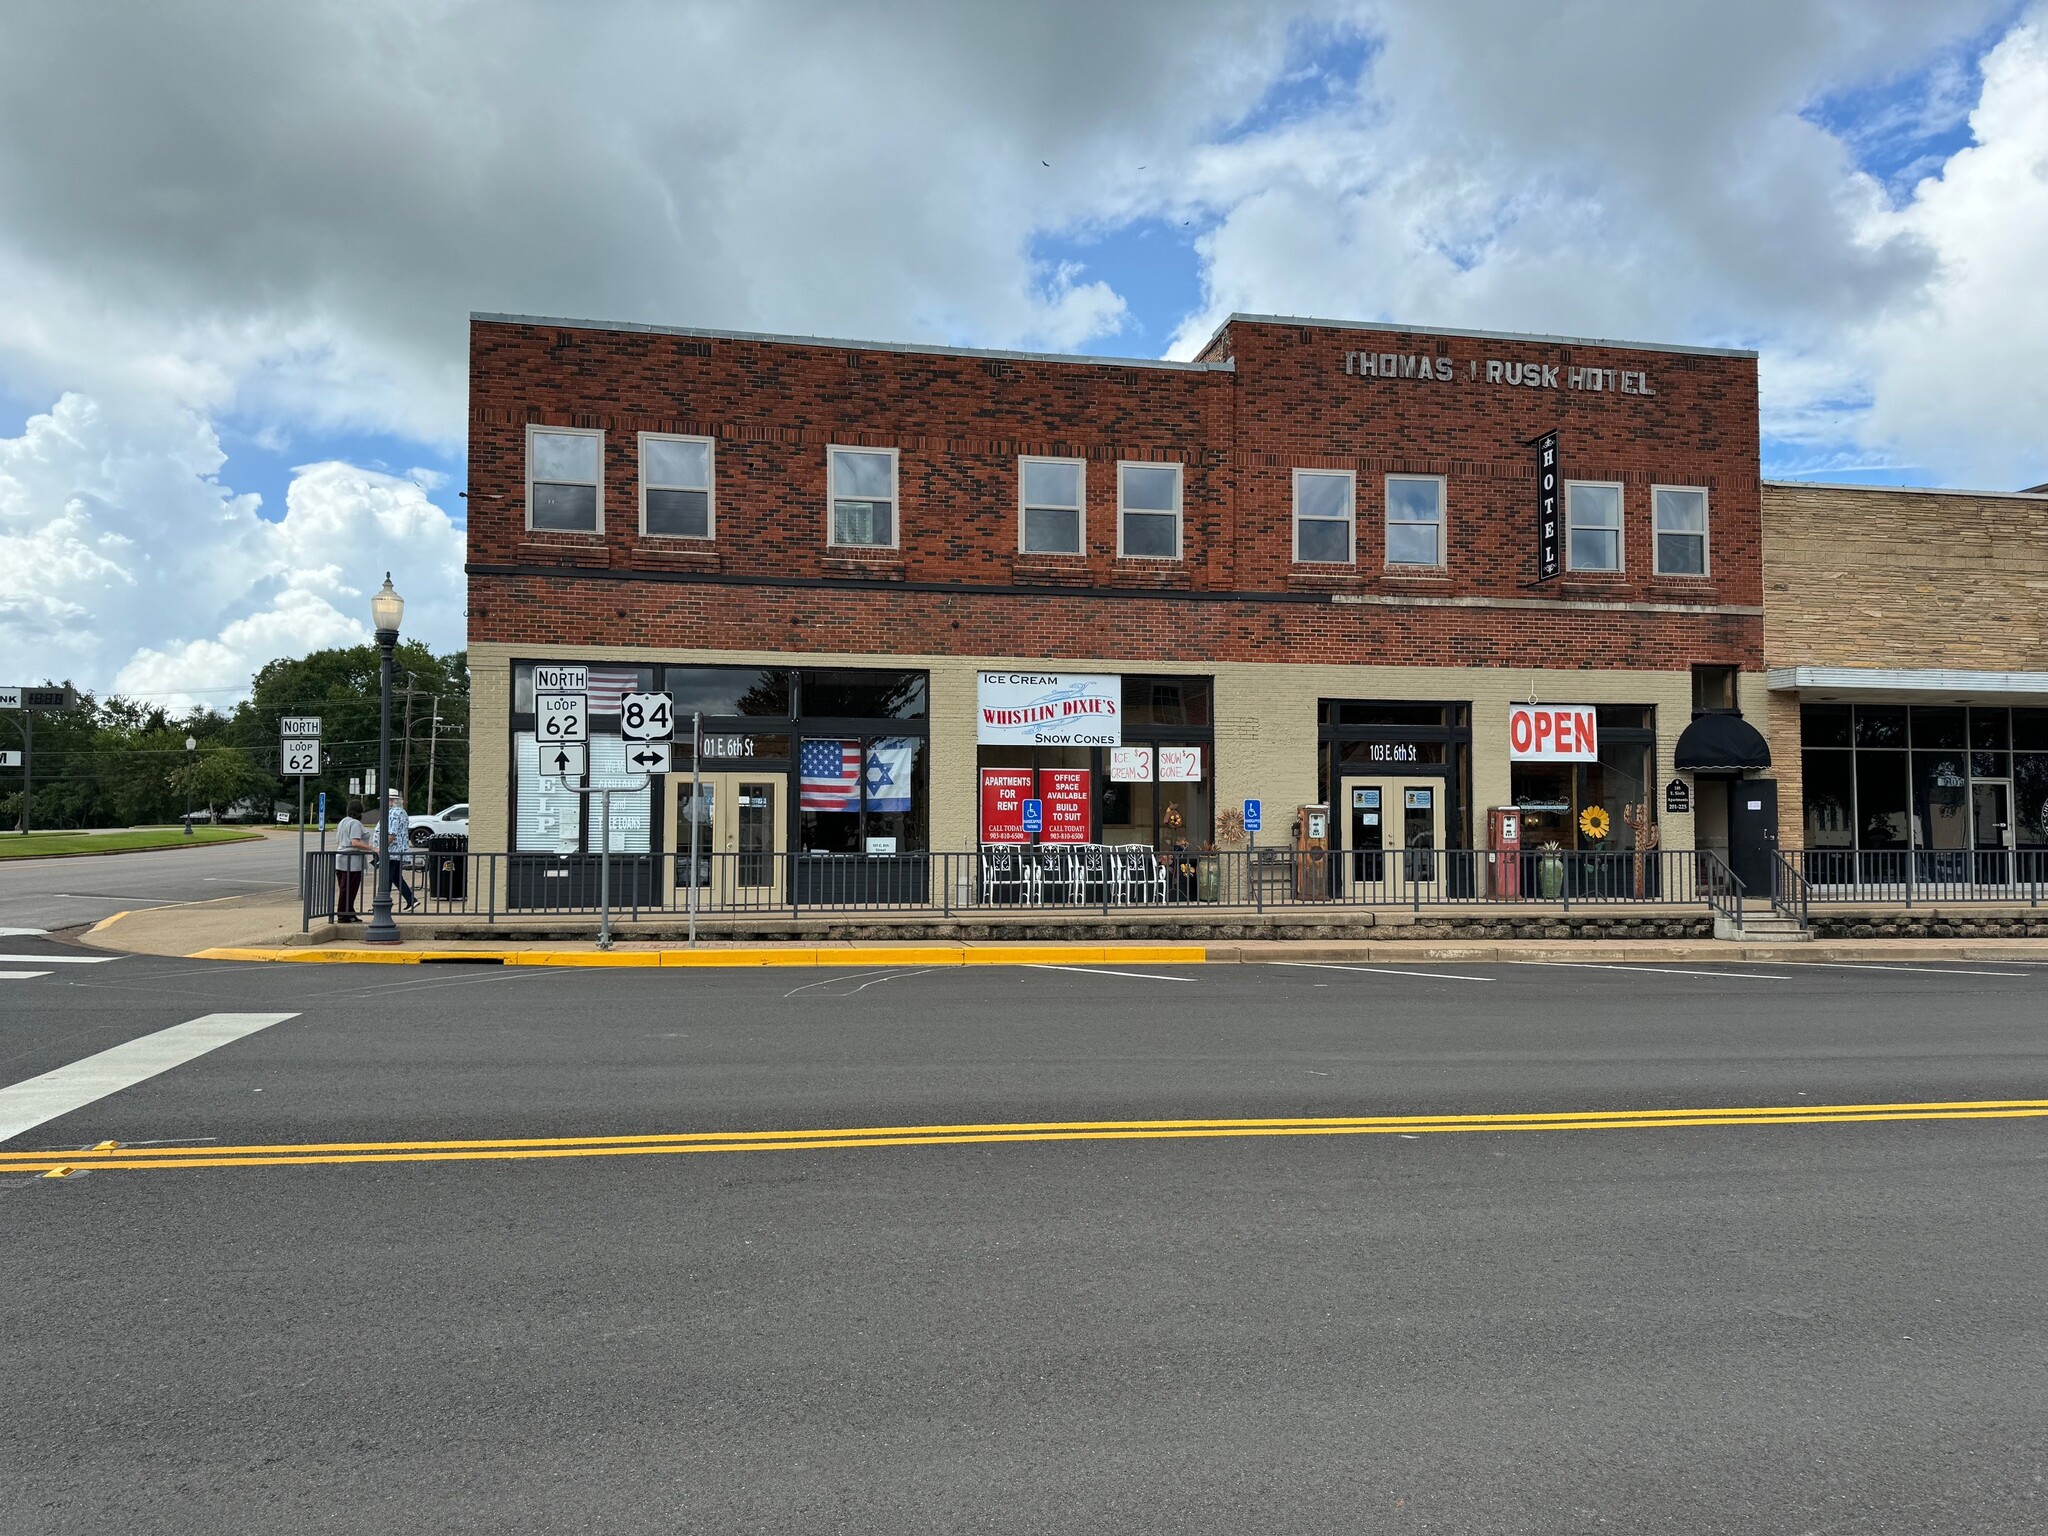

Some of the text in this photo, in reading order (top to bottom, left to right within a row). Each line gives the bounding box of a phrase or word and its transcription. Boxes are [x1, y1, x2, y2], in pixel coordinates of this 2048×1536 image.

[1346, 351, 1453, 382] THOMAS
[1486, 360, 1560, 388] RUSK
[1567, 366, 1657, 396] HOTEL
[1541, 449, 1555, 563] HOTEL
[538, 670, 585, 687] NORTH
[983, 674, 1058, 686] ICE CREAM
[546, 701, 577, 711] LOOP
[983, 699, 1116, 725] WHISTLIN' DIXIE'S
[626, 702, 669, 729] 84
[284, 720, 319, 733] NORTH
[546, 715, 578, 735] 62
[1510, 710, 1595, 753] OPEN
[1035, 733, 1115, 745] SNOW CONES
[289, 743, 313, 752] LOOP
[704, 738, 715, 756] 01
[727, 738, 743, 756] 6th
[744, 738, 754, 757] St
[1369, 744, 1417, 762] 103 E. 6th St
[289, 754, 313, 770] 62
[1114, 752, 1129, 763] ICE
[1160, 753, 1182, 765] SNOW
[1054, 774, 1081, 782] OFFICE
[1111, 767, 1136, 779] CREAM
[1160, 766, 1184, 778] CONE
[985, 776, 1031, 787] APARTMENTS
[1055, 783, 1079, 791] SPACE
[1000, 789, 1016, 799] FOR
[1047, 792, 1087, 800] AVAILABLE
[997, 801, 1019, 811] RENT
[1056, 803, 1078, 812] BUILD
[1052, 812, 1081, 821] TO SUIT
